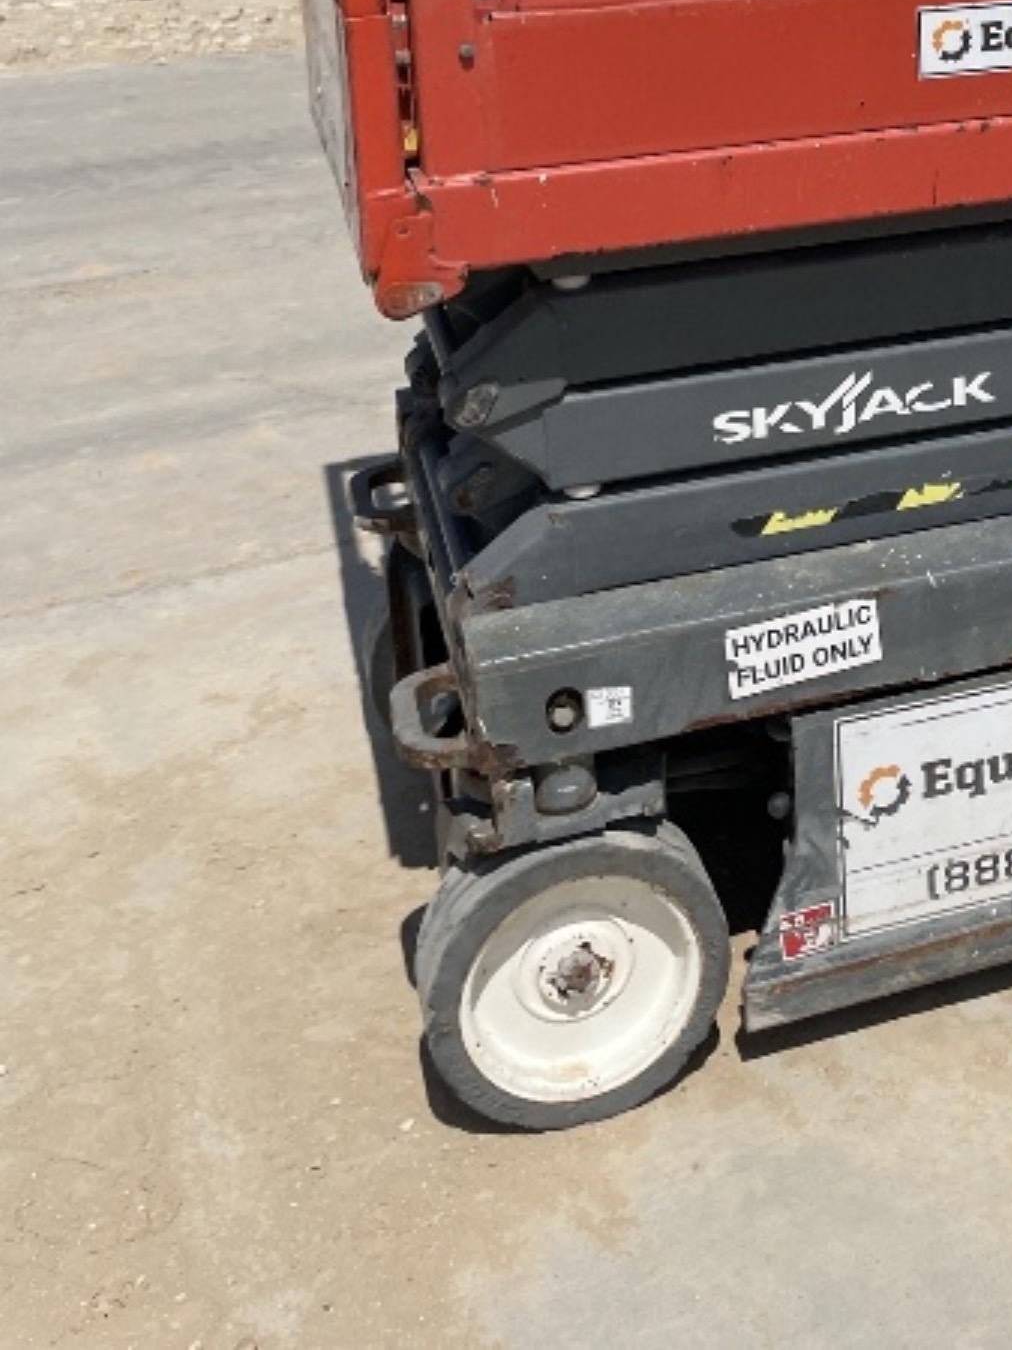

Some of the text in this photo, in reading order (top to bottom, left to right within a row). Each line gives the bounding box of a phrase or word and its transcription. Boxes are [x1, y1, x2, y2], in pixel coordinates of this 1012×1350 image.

[712, 368, 998, 446] SKYJACK
[731, 605, 872, 658] HYDRAULIC
[736, 633, 874, 688] FLUID ONLY
